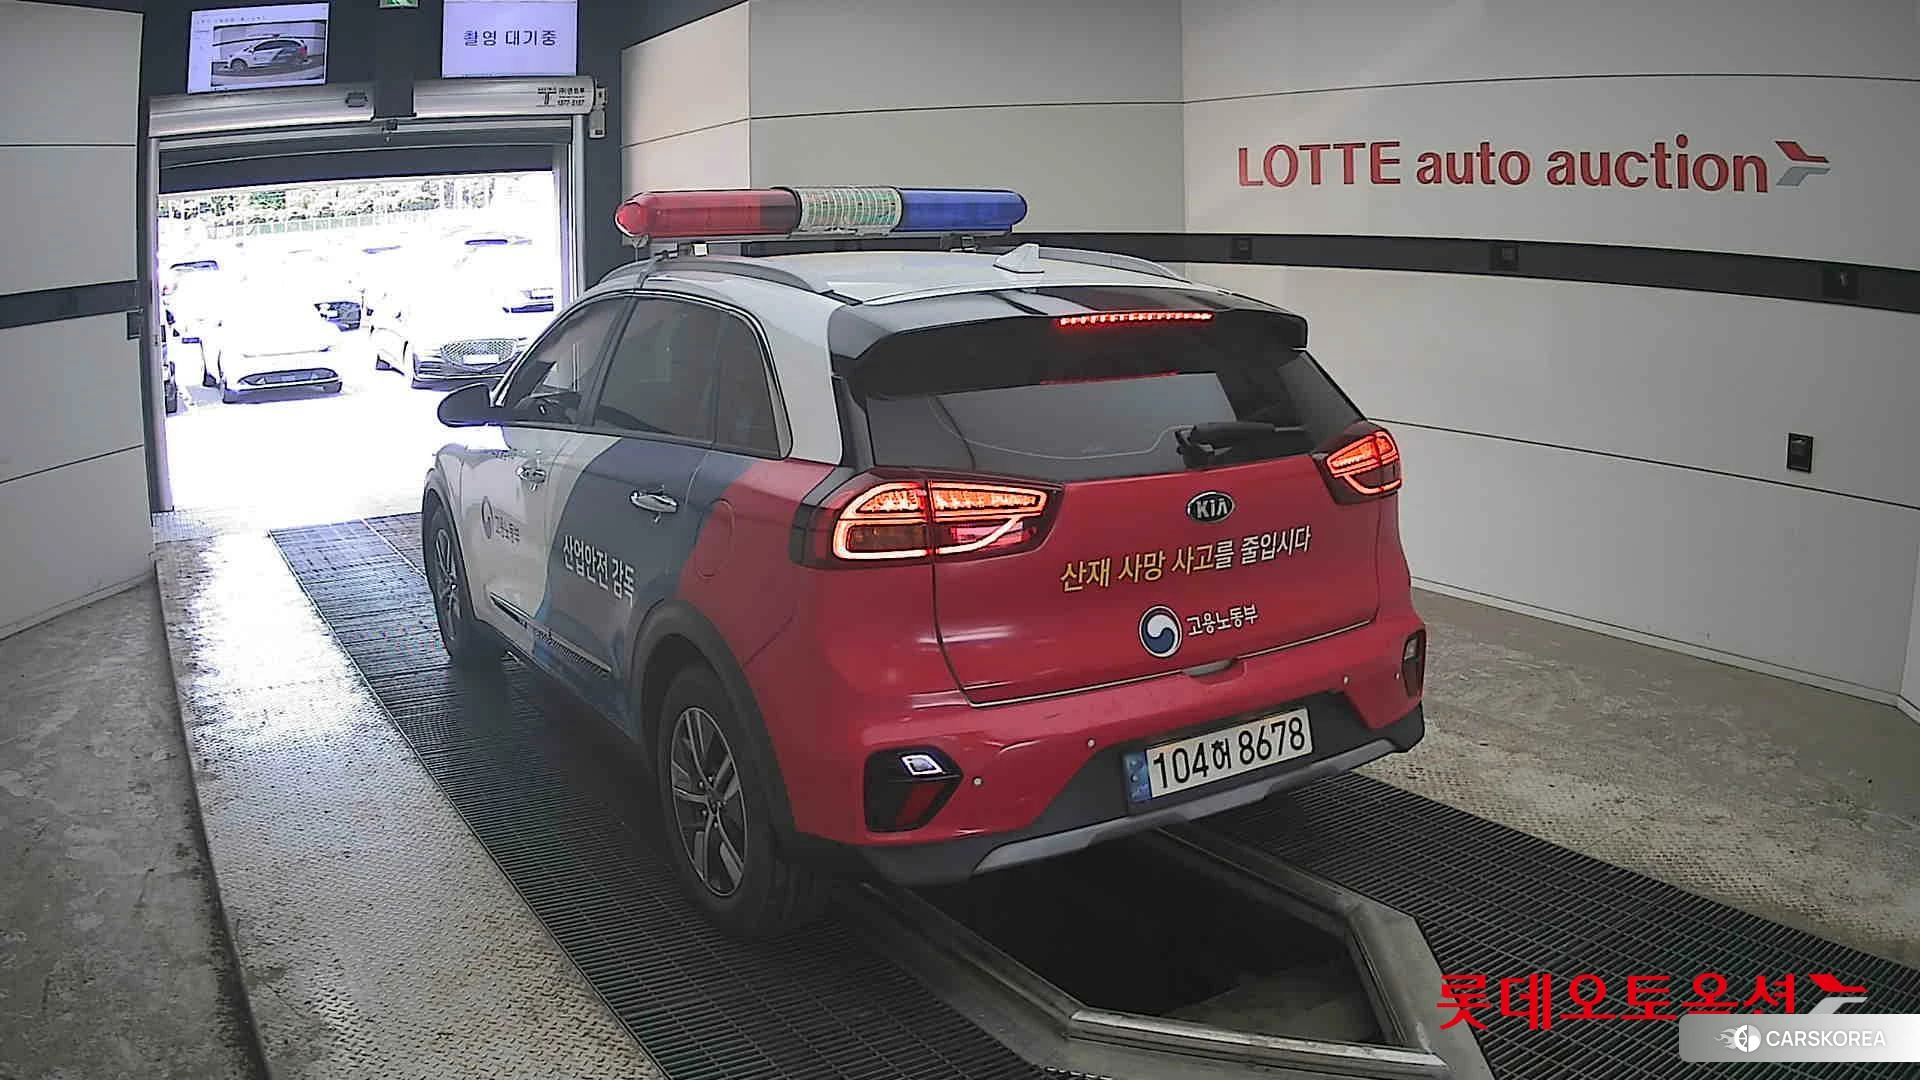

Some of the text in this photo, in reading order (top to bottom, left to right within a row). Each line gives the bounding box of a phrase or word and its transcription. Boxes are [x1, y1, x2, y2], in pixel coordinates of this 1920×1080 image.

[505, 30, 558, 46] 대기중
[1238, 134, 1768, 193] LOTTE auto auction
[1195, 497, 1229, 519] KIA
[562, 534, 637, 609] 산업안전 감독
[1060, 525, 1312, 592] 산재 사망 사고를 줄입시다
[1186, 603, 1260, 637] 고용노동부
[1153, 716, 1305, 789] 104허 8678
